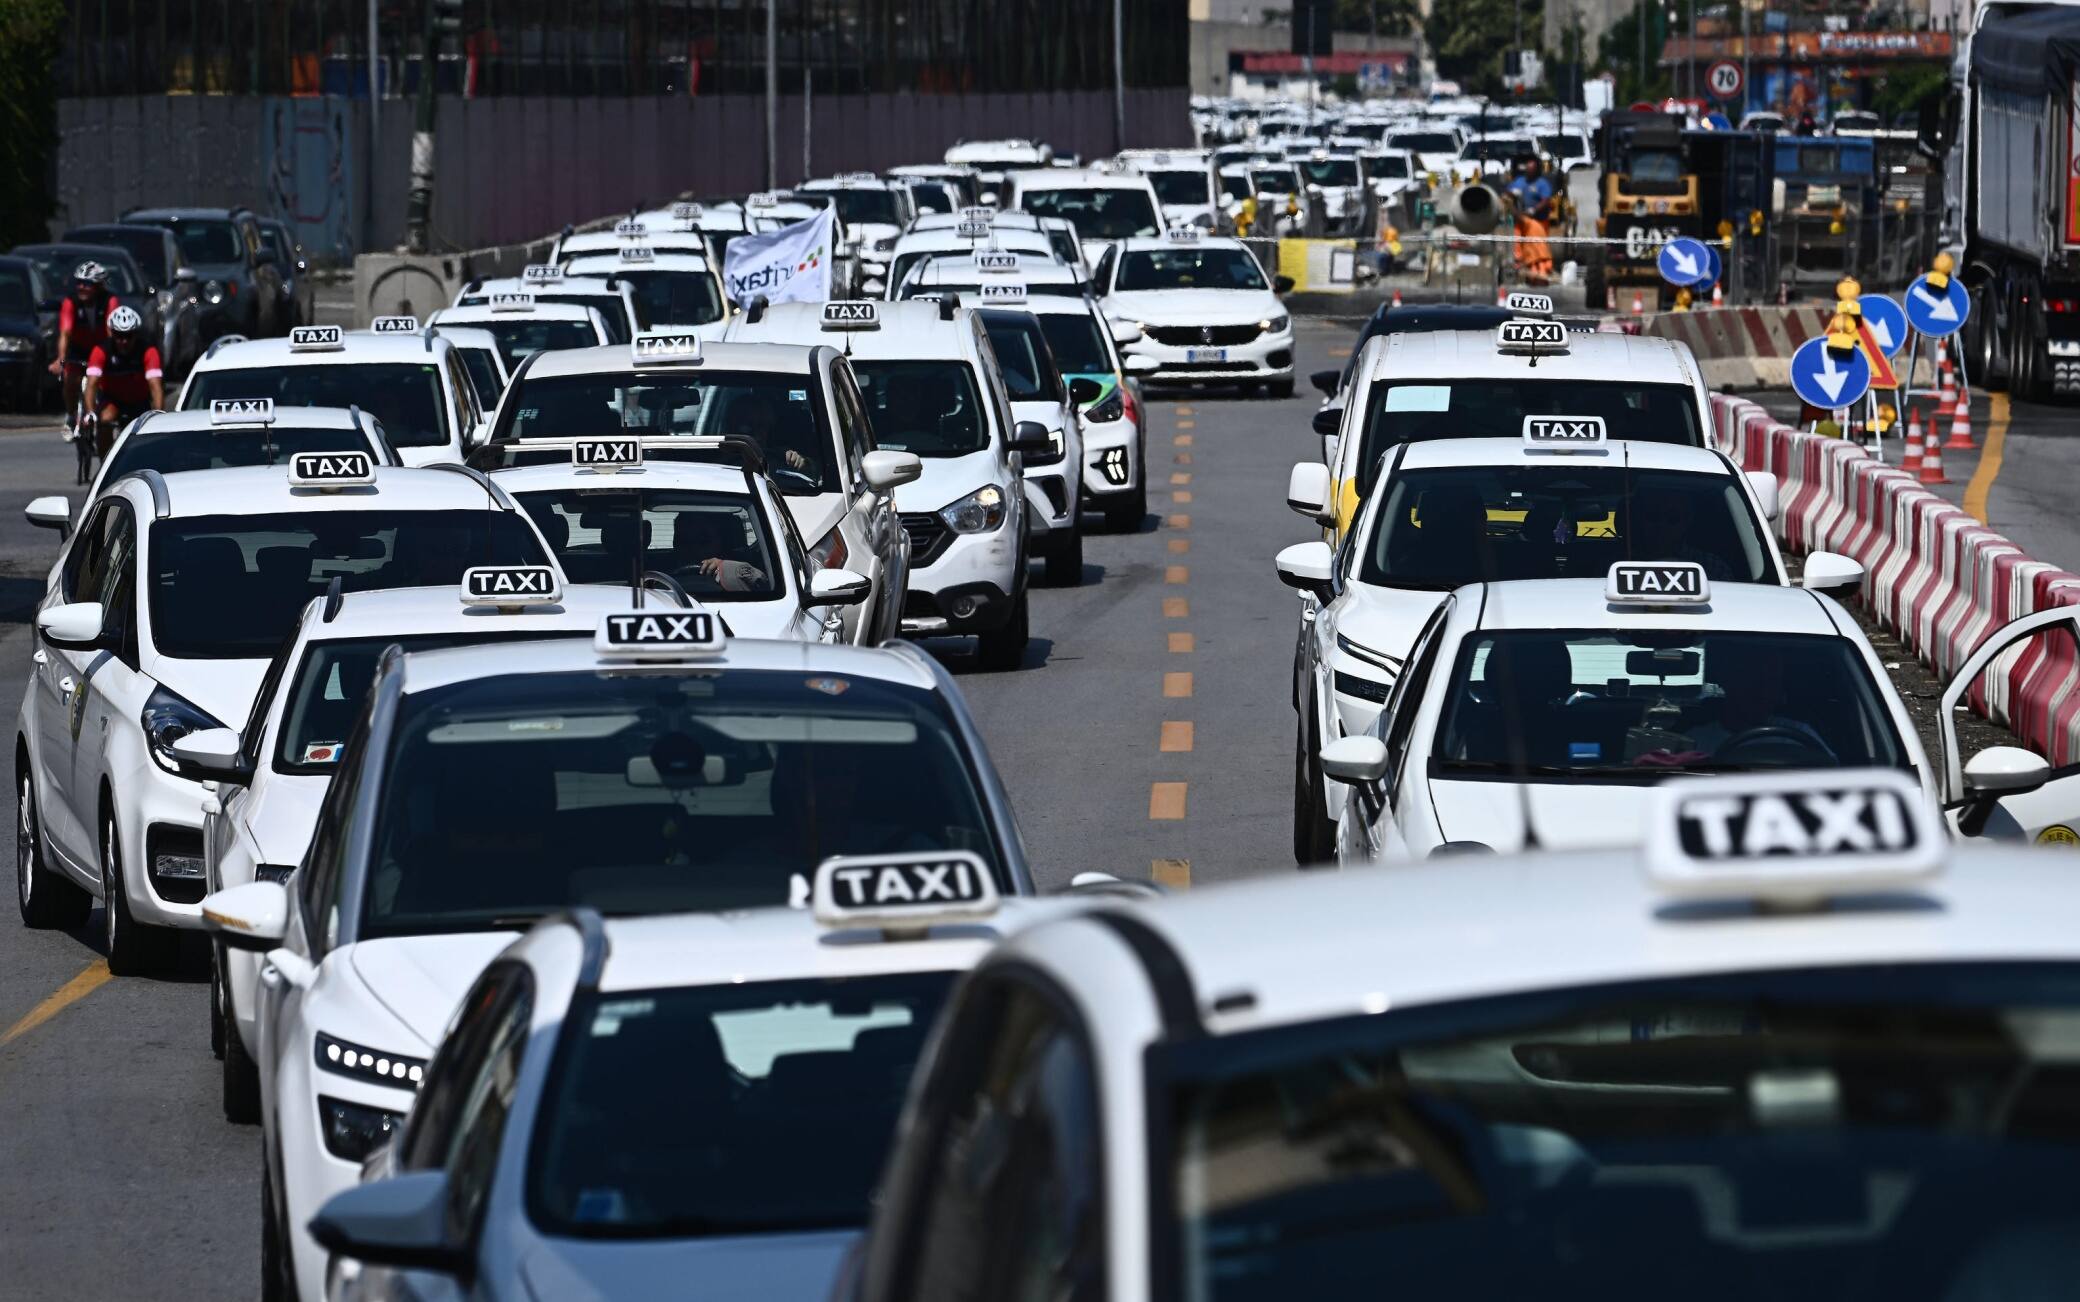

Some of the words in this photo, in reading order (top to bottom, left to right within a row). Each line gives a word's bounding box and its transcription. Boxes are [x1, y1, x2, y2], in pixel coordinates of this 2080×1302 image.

[1717, 69, 1736, 88] 70
[983, 257, 1014, 267] TAXI
[987, 287, 1022, 297] TAXI
[1512, 297, 1547, 309] TAXI
[827, 305, 871, 319] TAXI
[379, 319, 413, 331] TAXI
[1505, 326, 1559, 340] TAXI
[296, 330, 337, 342] TAXI
[638, 337, 692, 354] TAXI
[217, 402, 270, 414] TAXI
[1533, 422, 1595, 438] TAXI
[578, 443, 634, 461] TAXI
[299, 457, 364, 476] TAXI
[473, 572, 548, 592] TAXI
[1619, 570, 1695, 592] TAXI
[610, 617, 707, 641] TAXI
[1681, 789, 1906, 858] TAXI
[836, 863, 973, 904] TAXI
